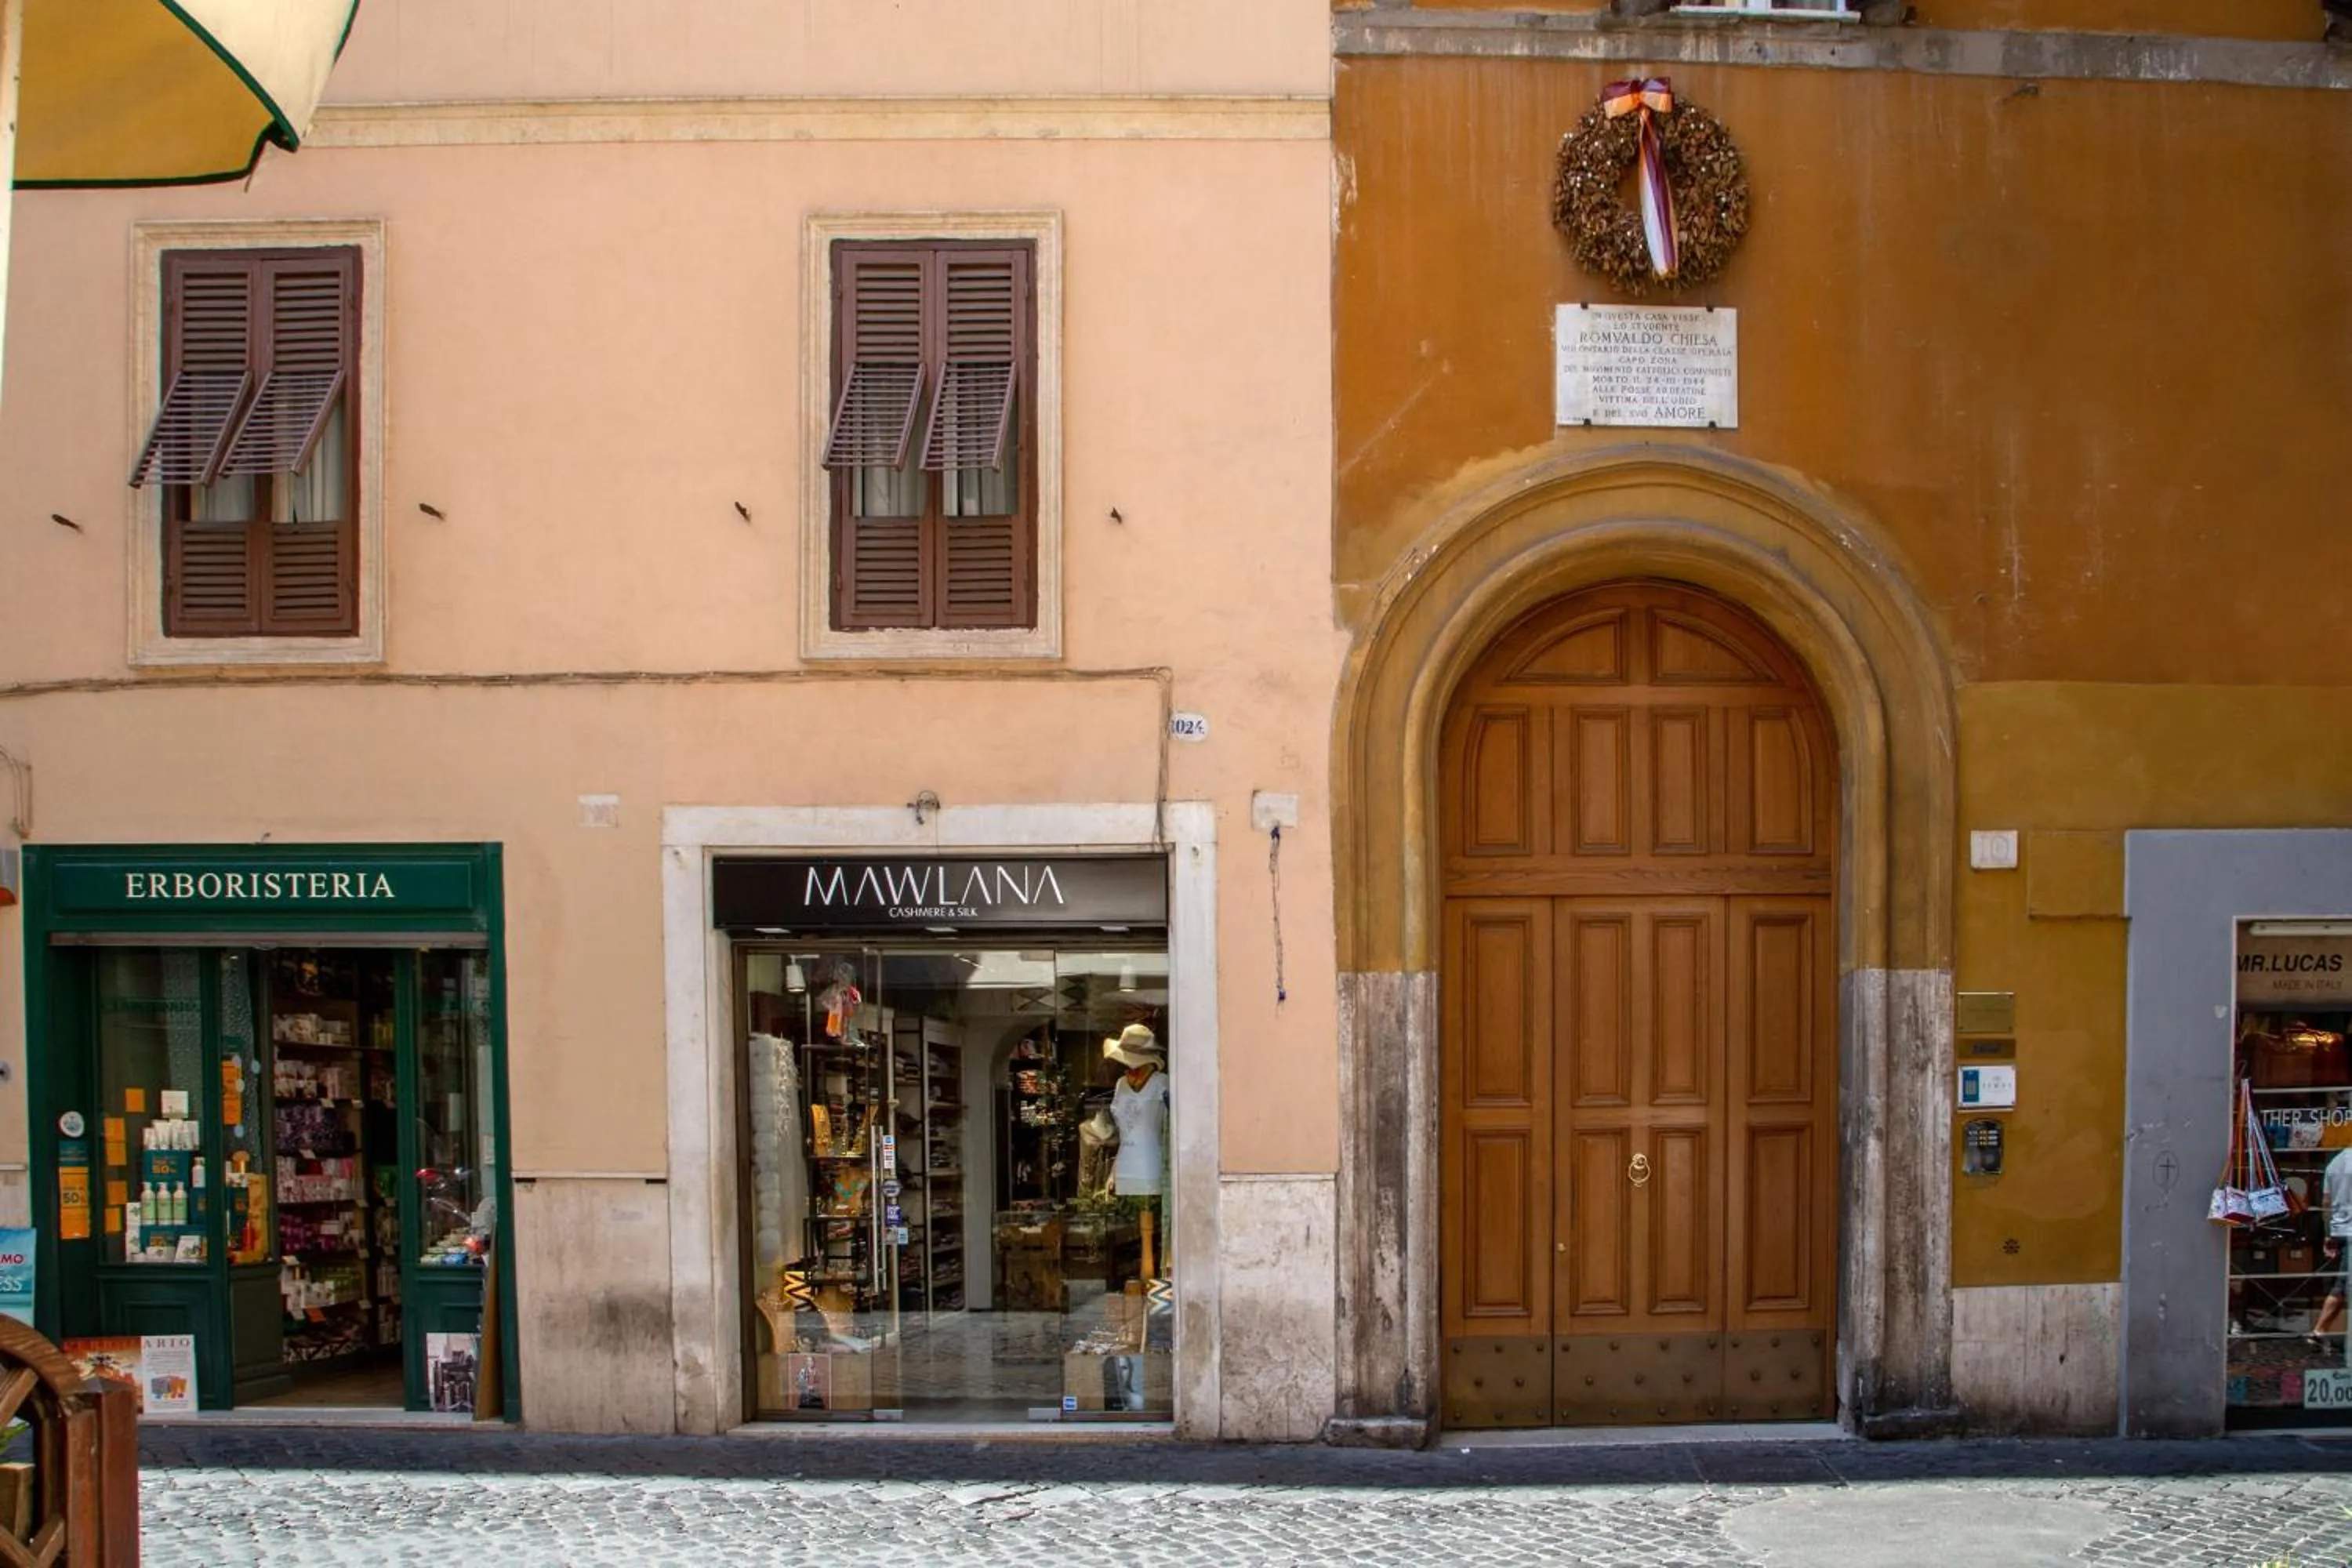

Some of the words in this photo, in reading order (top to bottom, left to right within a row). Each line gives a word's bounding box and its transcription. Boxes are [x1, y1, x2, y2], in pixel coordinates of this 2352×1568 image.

[1580, 332, 1663, 344] ROMVALDO
[1671, 333, 1719, 347] CHIESA
[1654, 406, 1707, 419] AMORE
[125, 872, 395, 898] ERBORISTERIA
[804, 865, 1065, 906] MAWLANA
[888, 907, 946, 919] CASHMERE
[949, 908, 956, 917] &
[957, 907, 978, 917] SILK
[0, 1254, 24, 1265] MO
